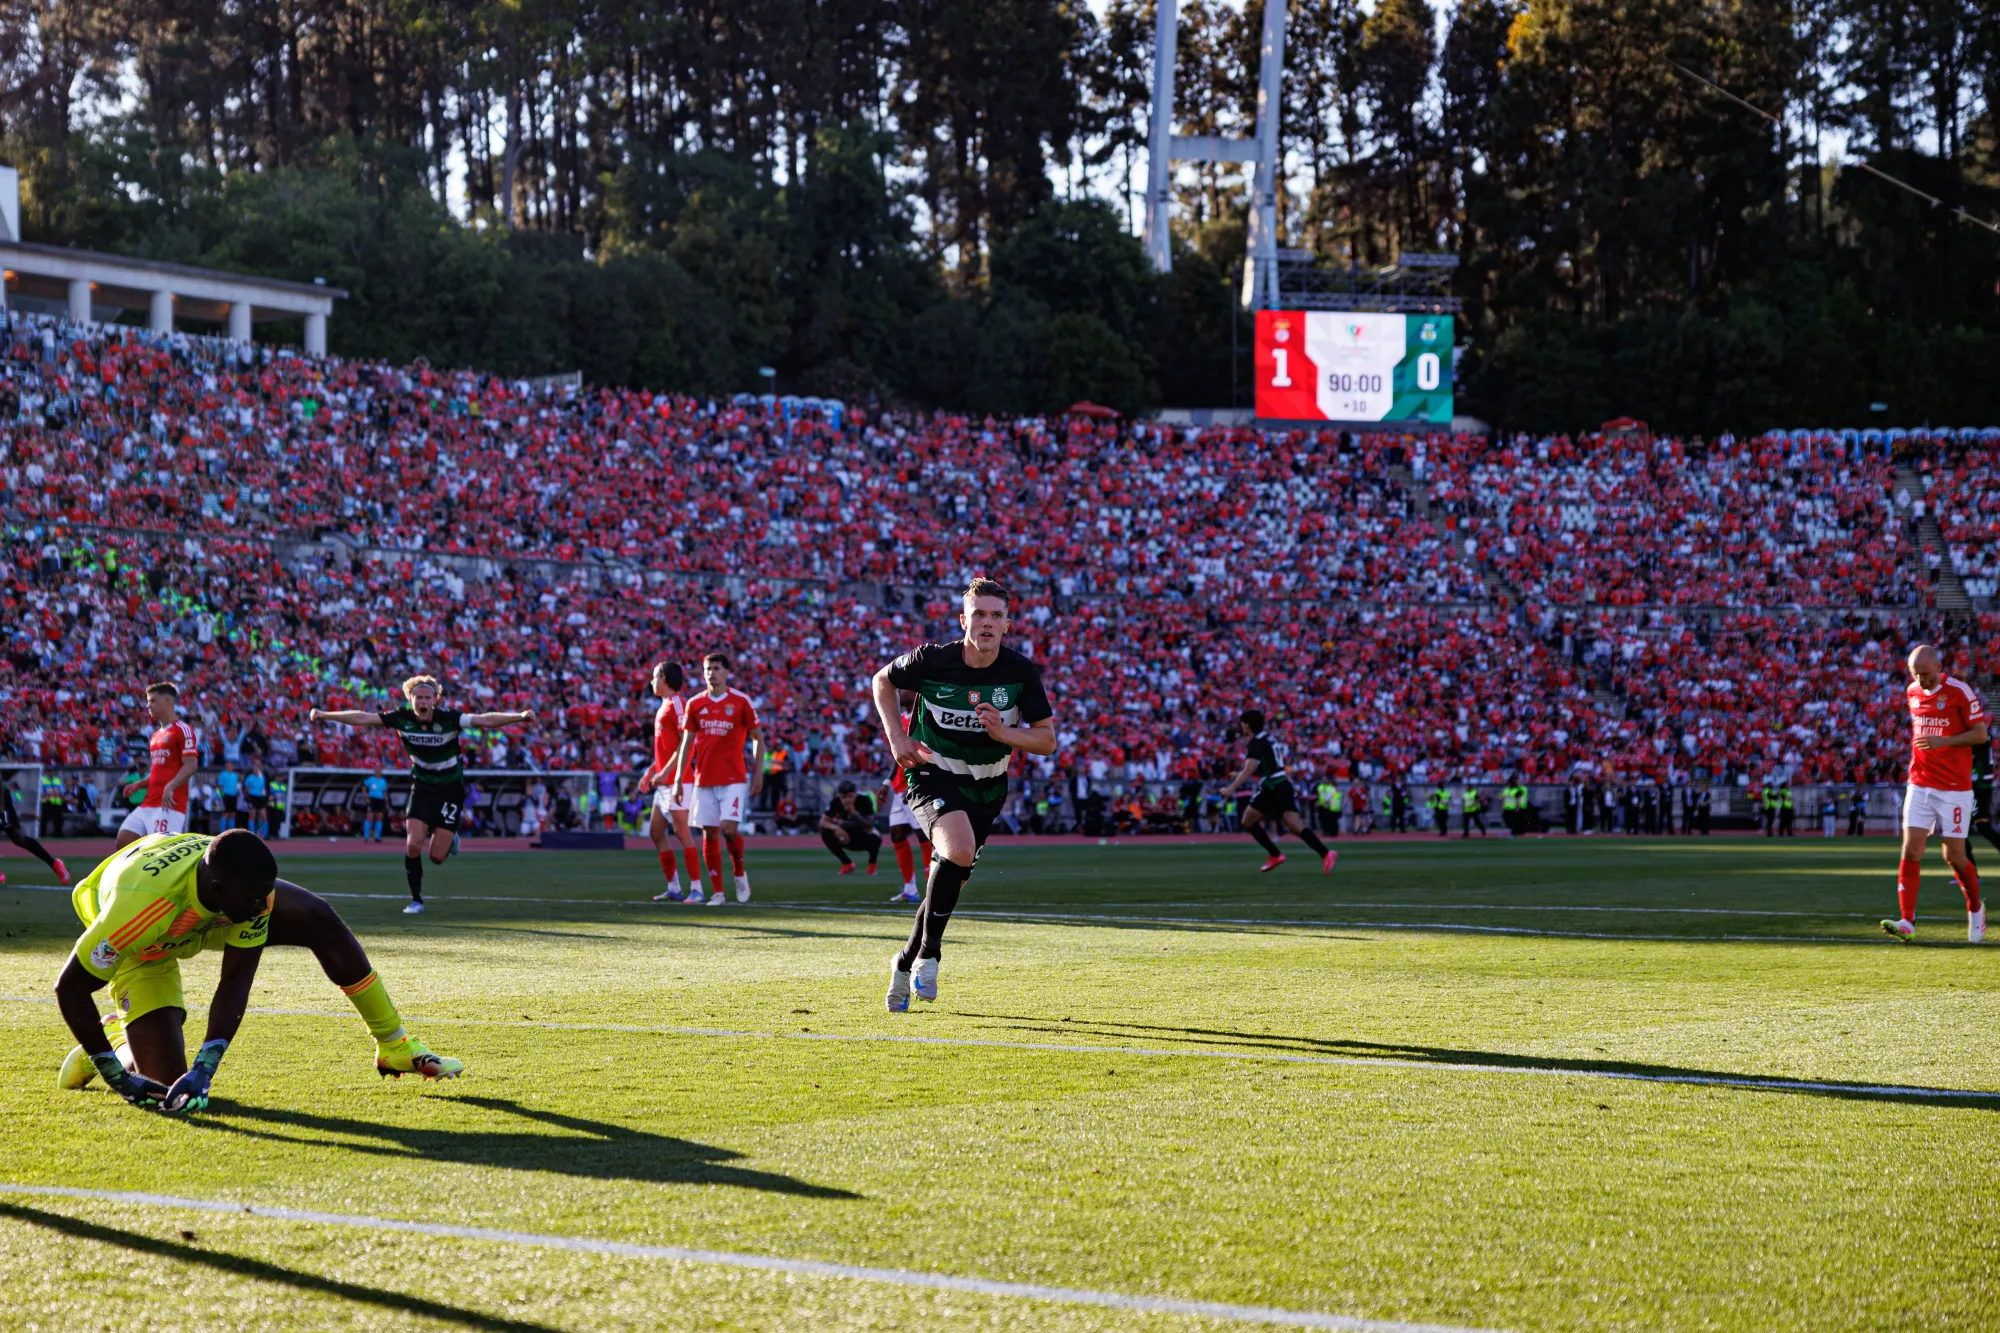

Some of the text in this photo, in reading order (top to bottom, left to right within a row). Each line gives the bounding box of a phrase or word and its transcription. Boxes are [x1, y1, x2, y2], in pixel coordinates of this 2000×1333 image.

[1271, 348, 1292, 387] 1
[1417, 353, 1440, 390] 0
[1329, 374, 1382, 392] 90:00
[941, 711, 1004, 729] Beta
[441, 802, 458, 820] 42
[733, 796, 739, 809] 4
[1953, 807, 1962, 825] 8
[154, 820, 168, 833] 26
